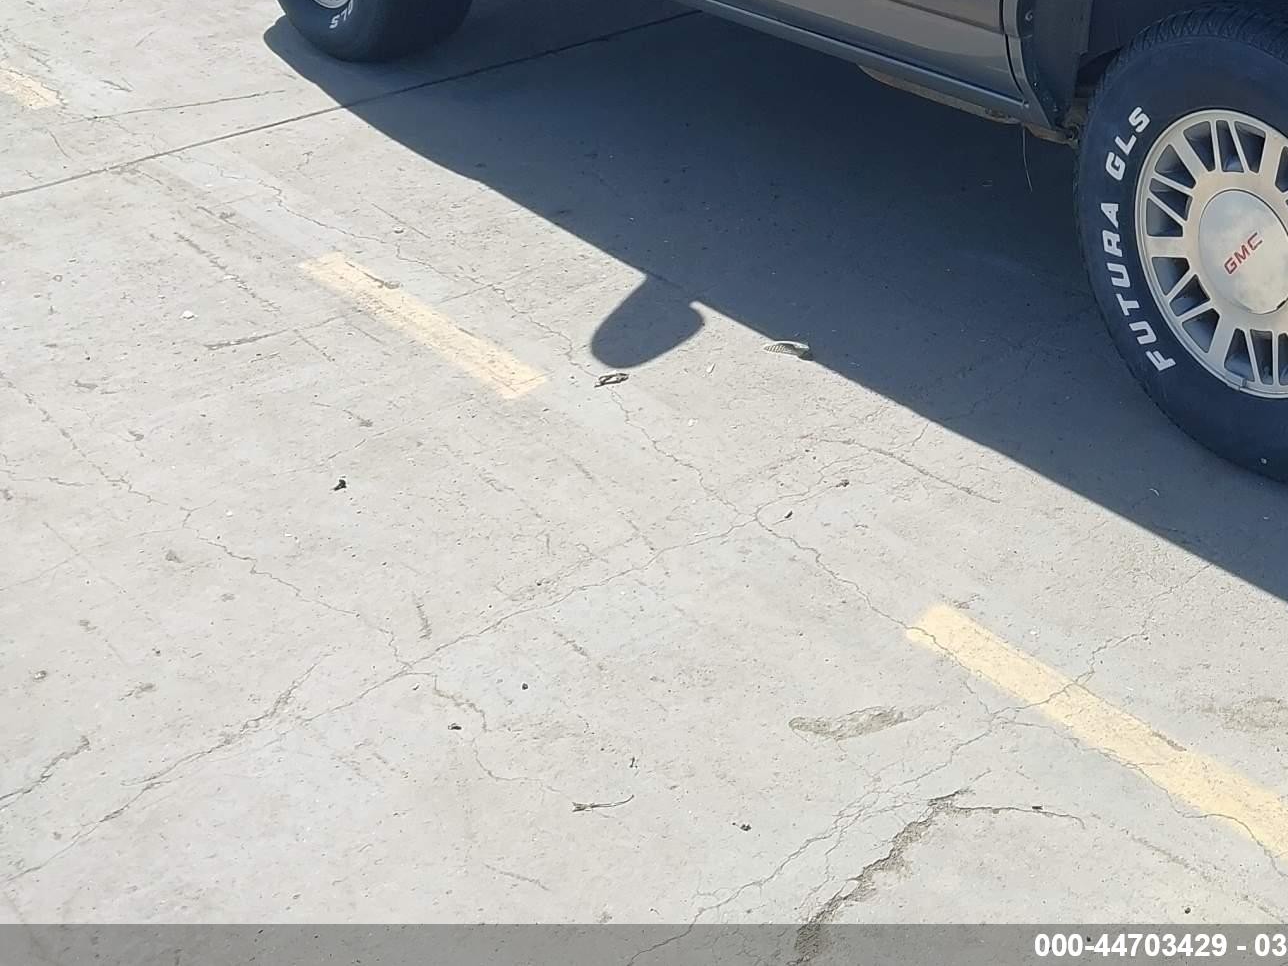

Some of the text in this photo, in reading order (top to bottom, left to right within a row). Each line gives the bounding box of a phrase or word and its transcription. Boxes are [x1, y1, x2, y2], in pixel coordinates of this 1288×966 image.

[1100, 106, 1176, 372] FUTURA GLS
[1223, 232, 1264, 276] GMC
